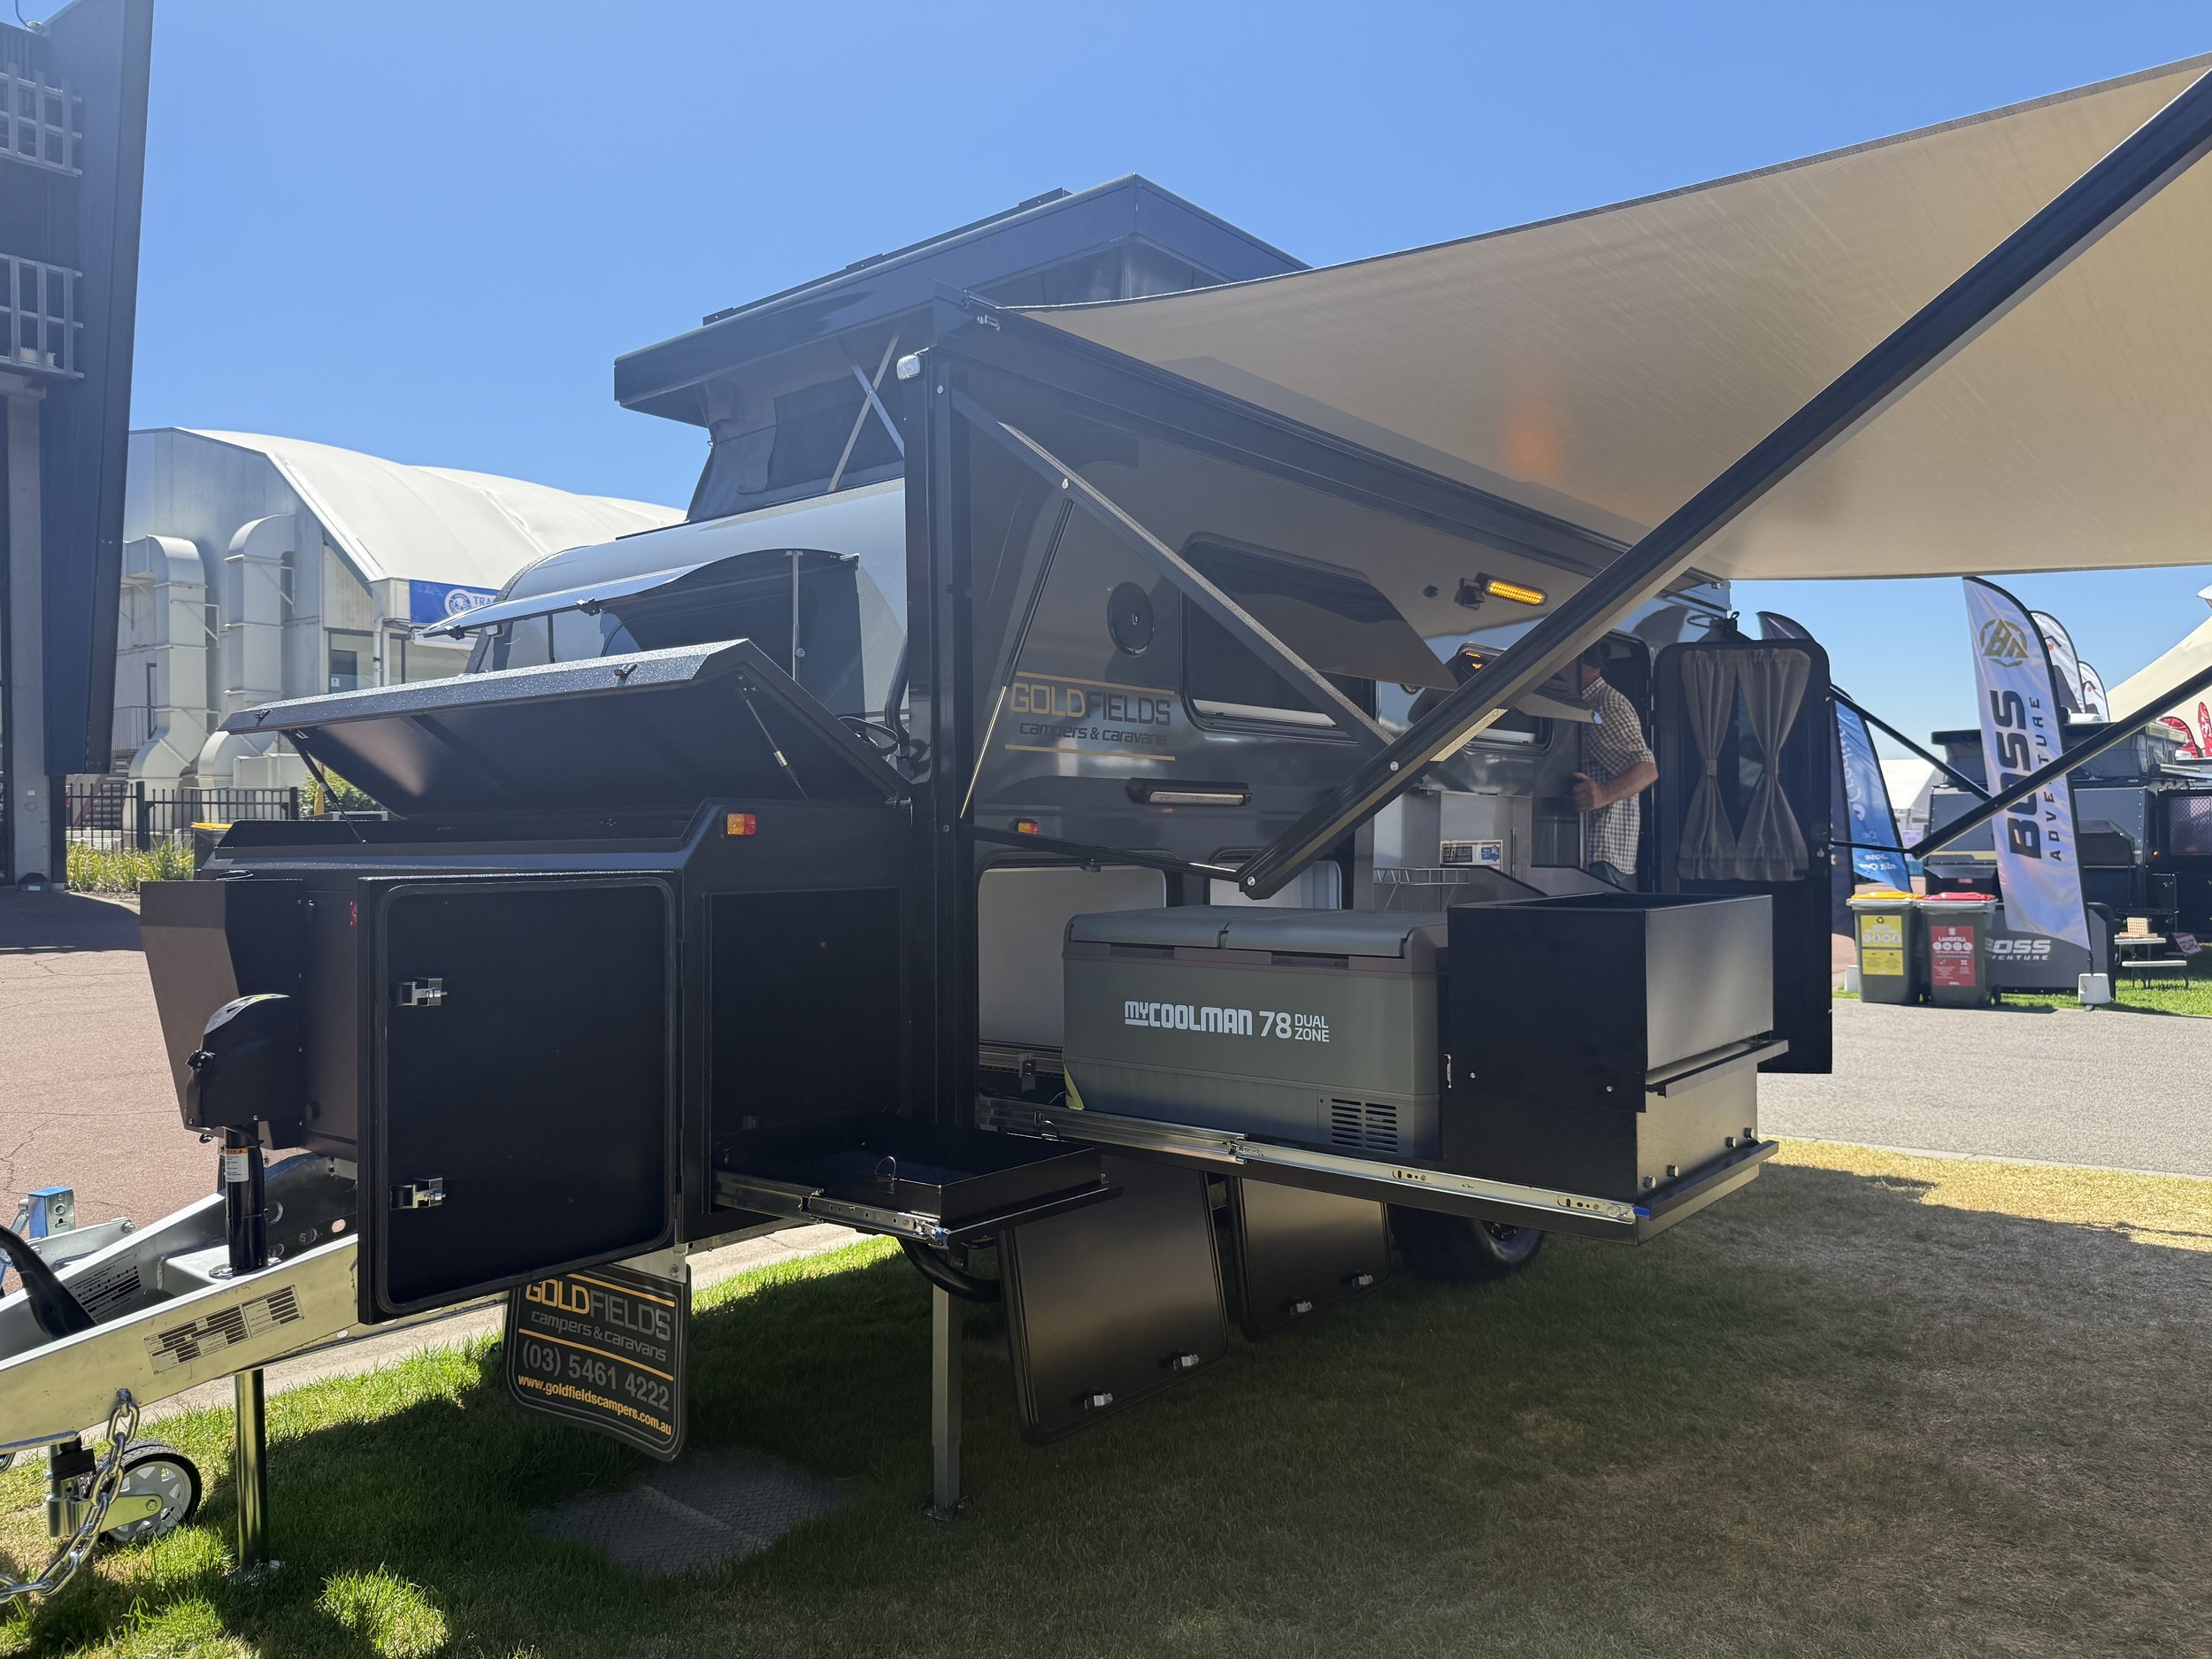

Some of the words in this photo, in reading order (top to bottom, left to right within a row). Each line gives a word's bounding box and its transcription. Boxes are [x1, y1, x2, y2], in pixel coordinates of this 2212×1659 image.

[1010, 682, 1171, 726] GOLDFIELDS
[1019, 722, 1087, 741] campers
[1090, 726, 1099, 741] &
[1102, 729, 1168, 745] caravans
[2029, 696, 2062, 862] ADVETURE
[1985, 939, 2052, 954] OSS
[1259, 1010, 1292, 1039] 78
[1294, 1027, 1330, 1042] ZONE
[1295, 1013, 1329, 1029] DUAL
[526, 1279, 672, 1341] GOLDFIELDS
[532, 1310, 592, 1337] campers
[593, 1326, 603, 1340] &
[604, 1331, 666, 1362] caravans
[522, 1340, 561, 1377] (03)
[568, 1354, 618, 1390] 5461
[625, 1372, 670, 1412] 4222
[518, 1374, 672, 1436] www.goldfieldscampers.com.au
